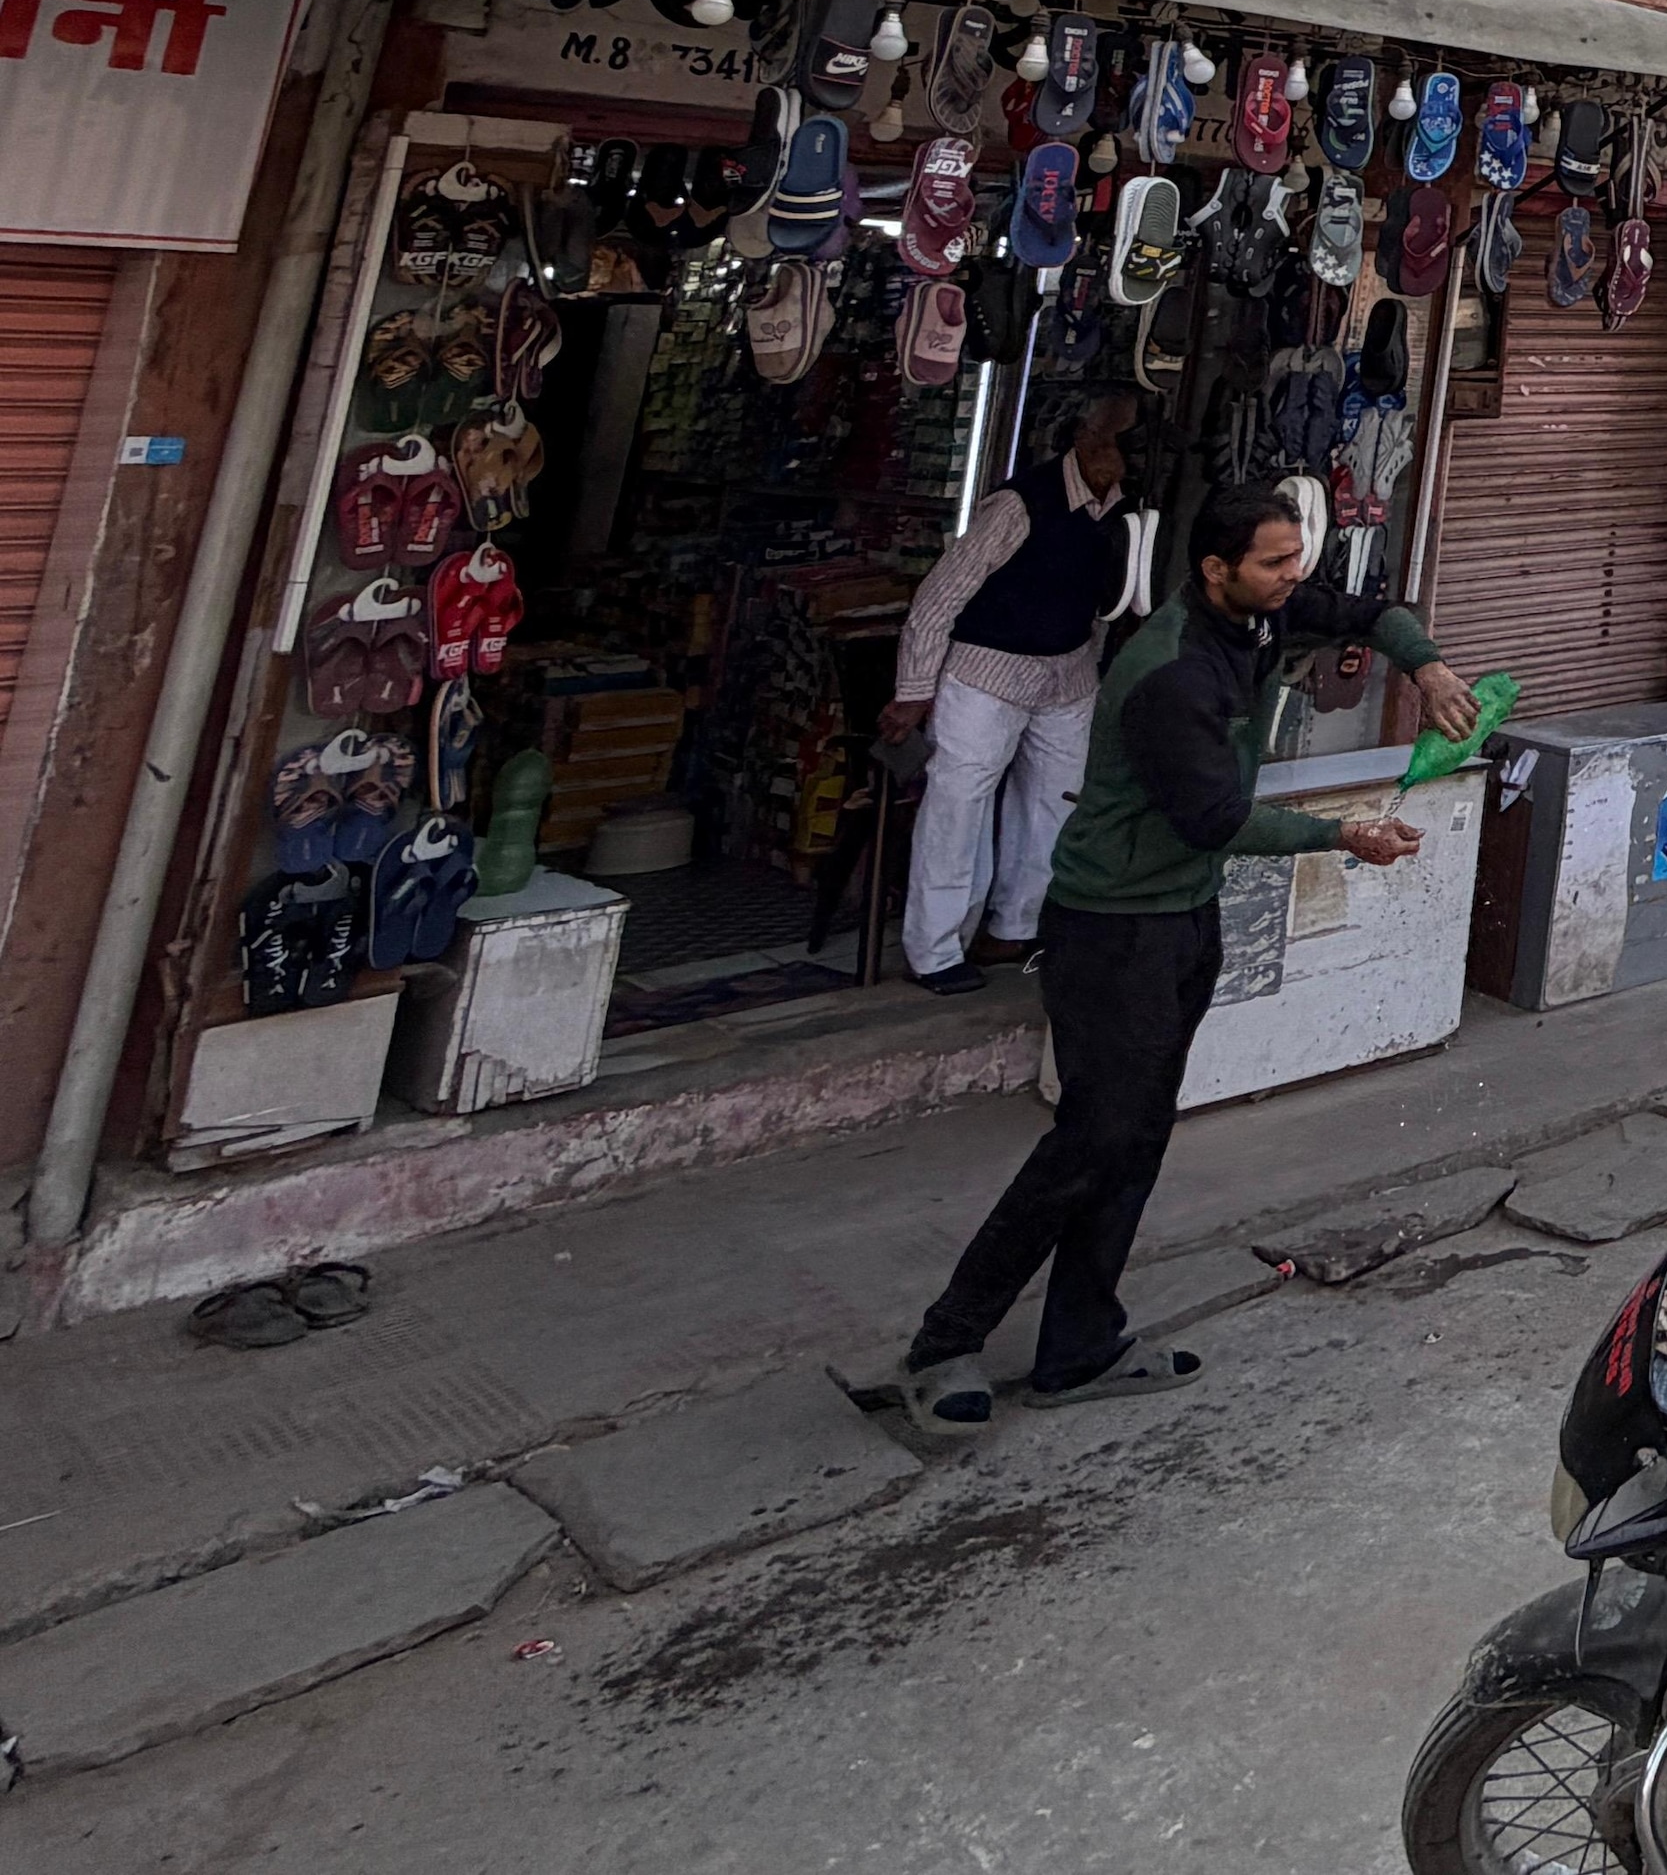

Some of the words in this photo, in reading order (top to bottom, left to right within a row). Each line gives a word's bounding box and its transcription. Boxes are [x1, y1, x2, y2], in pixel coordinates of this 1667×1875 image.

[924, 158, 973, 179] KGF
[399, 250, 449, 267] KGF
[448, 251, 498, 268] KGF
[437, 639, 471, 661] KGF
[480, 636, 508, 654] KGF
